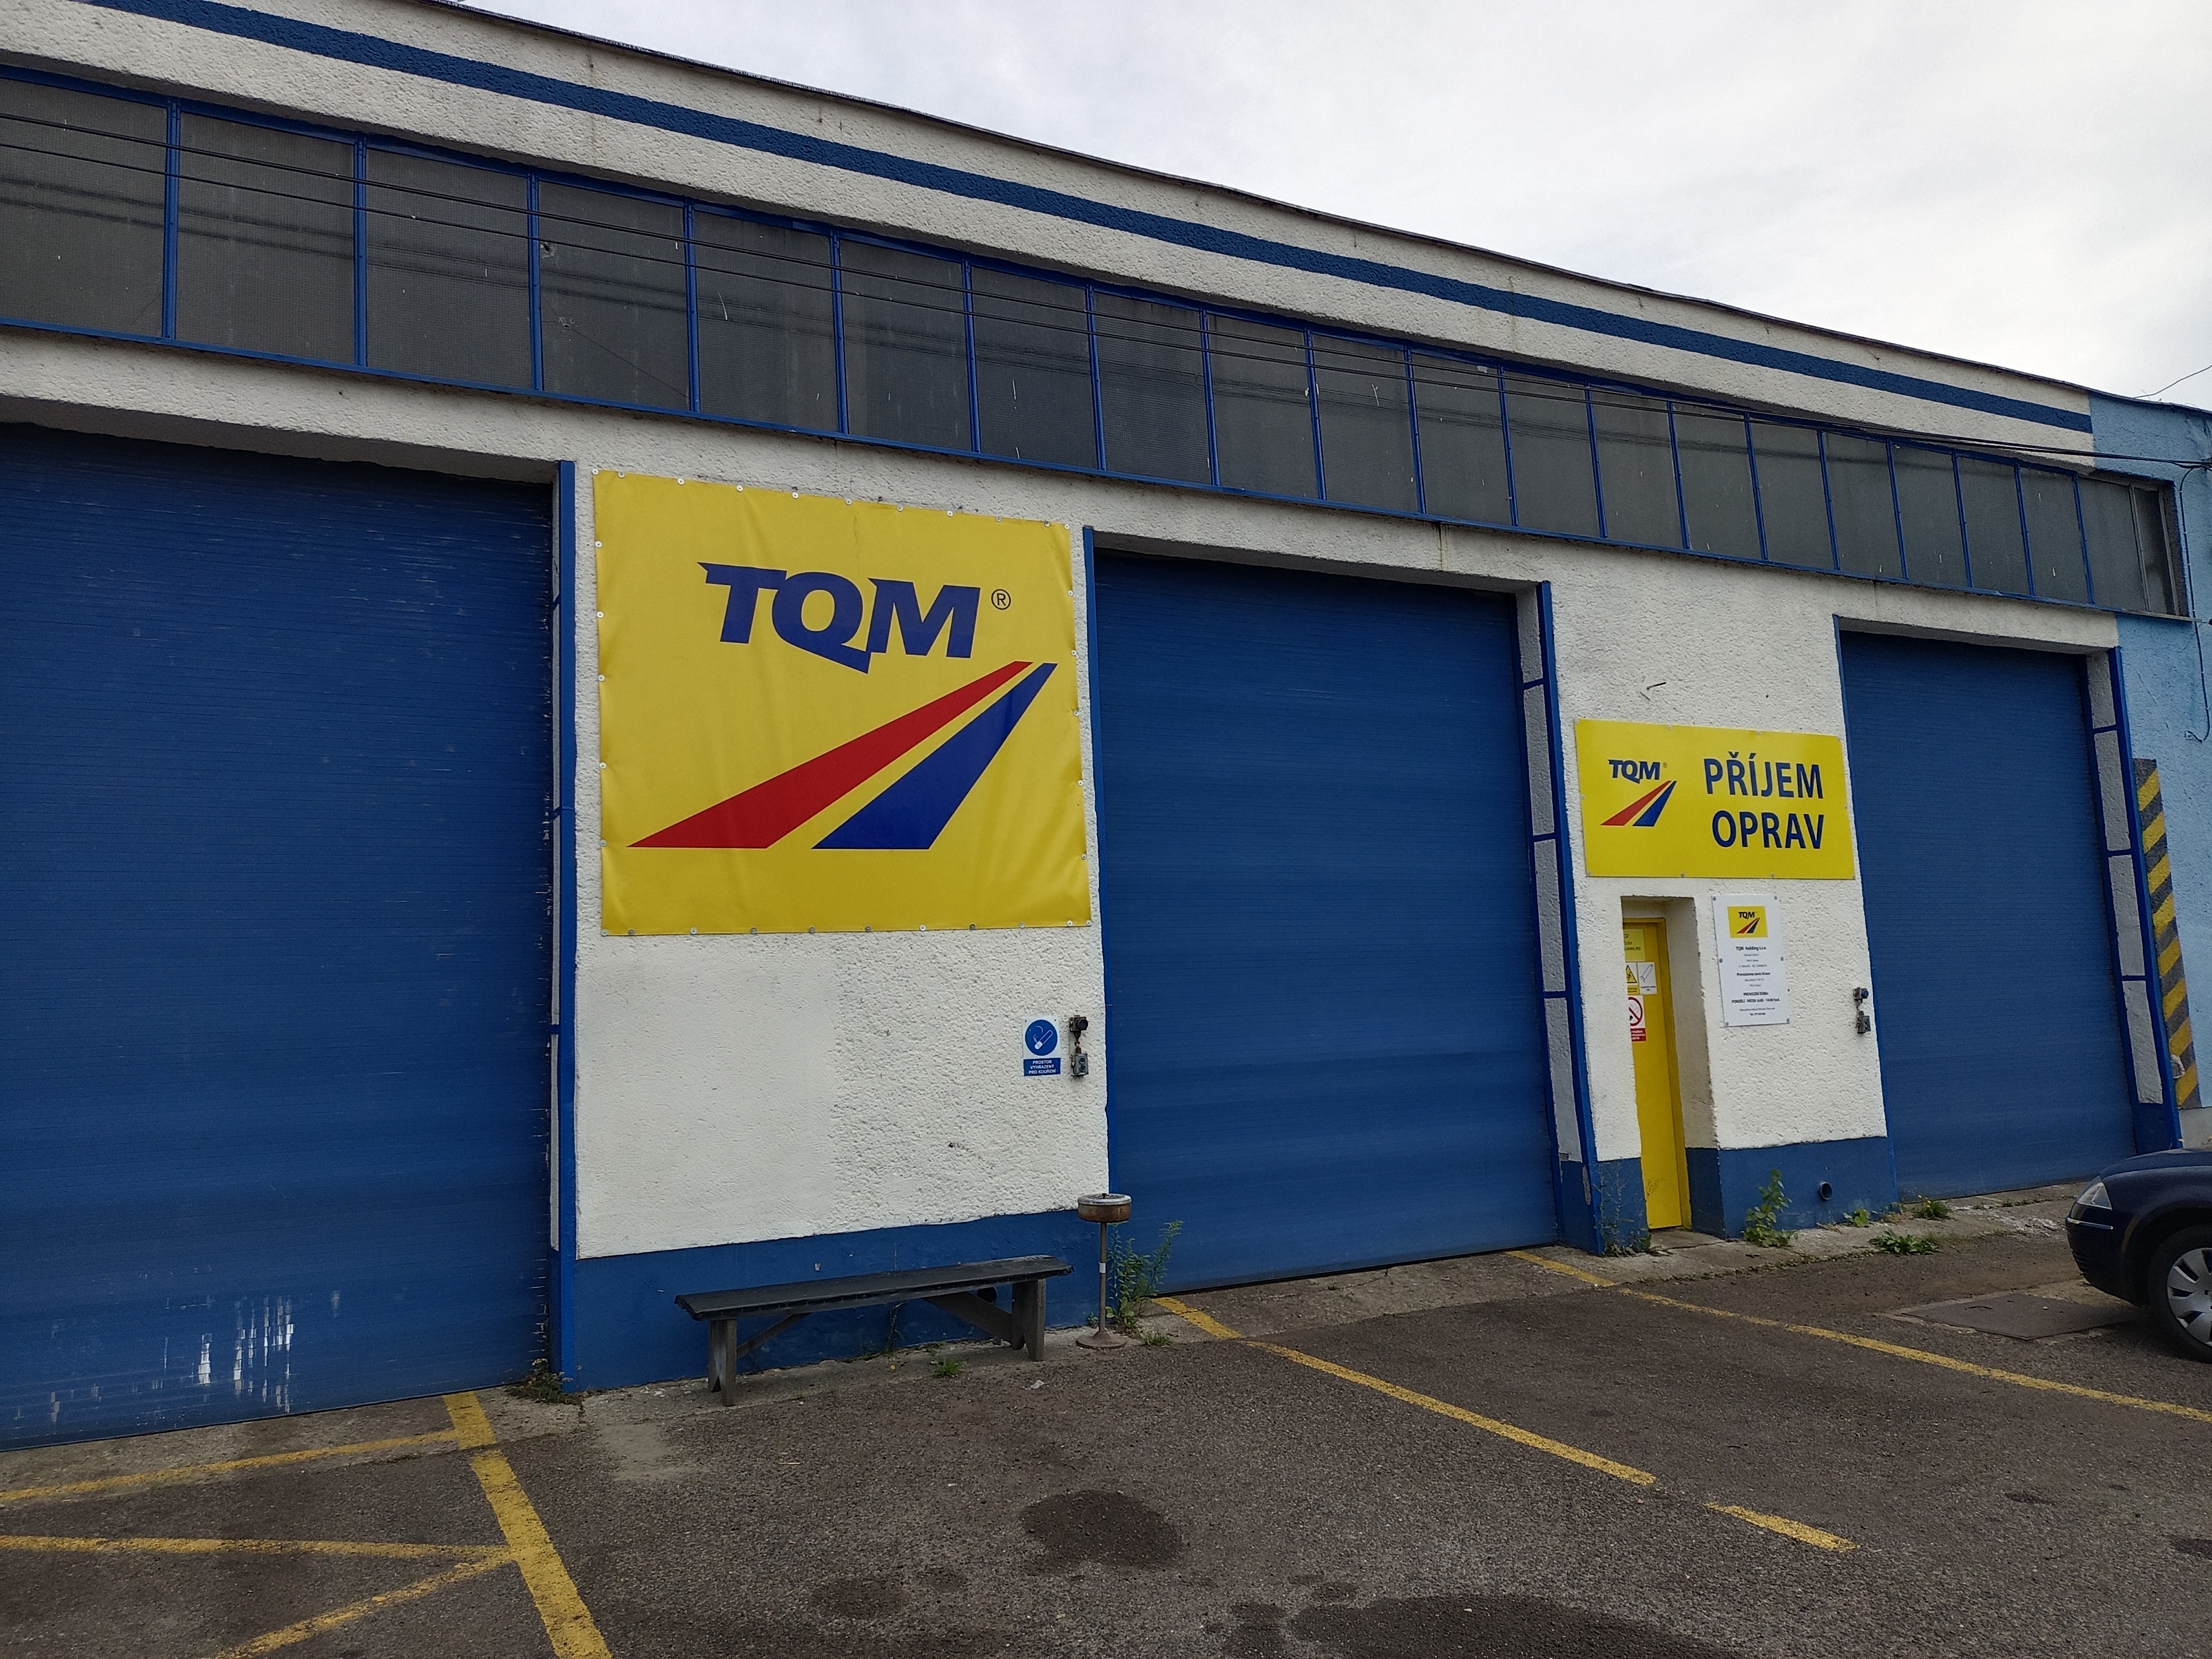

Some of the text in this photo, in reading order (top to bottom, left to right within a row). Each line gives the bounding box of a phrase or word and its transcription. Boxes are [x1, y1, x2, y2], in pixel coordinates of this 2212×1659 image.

[697, 562, 980, 674] TQM
[1607, 759, 1660, 784] TQM
[1704, 751, 1823, 799] PŘÍJEM
[1712, 810, 1824, 849] OPRAV
[1738, 911, 1755, 920] TQM
